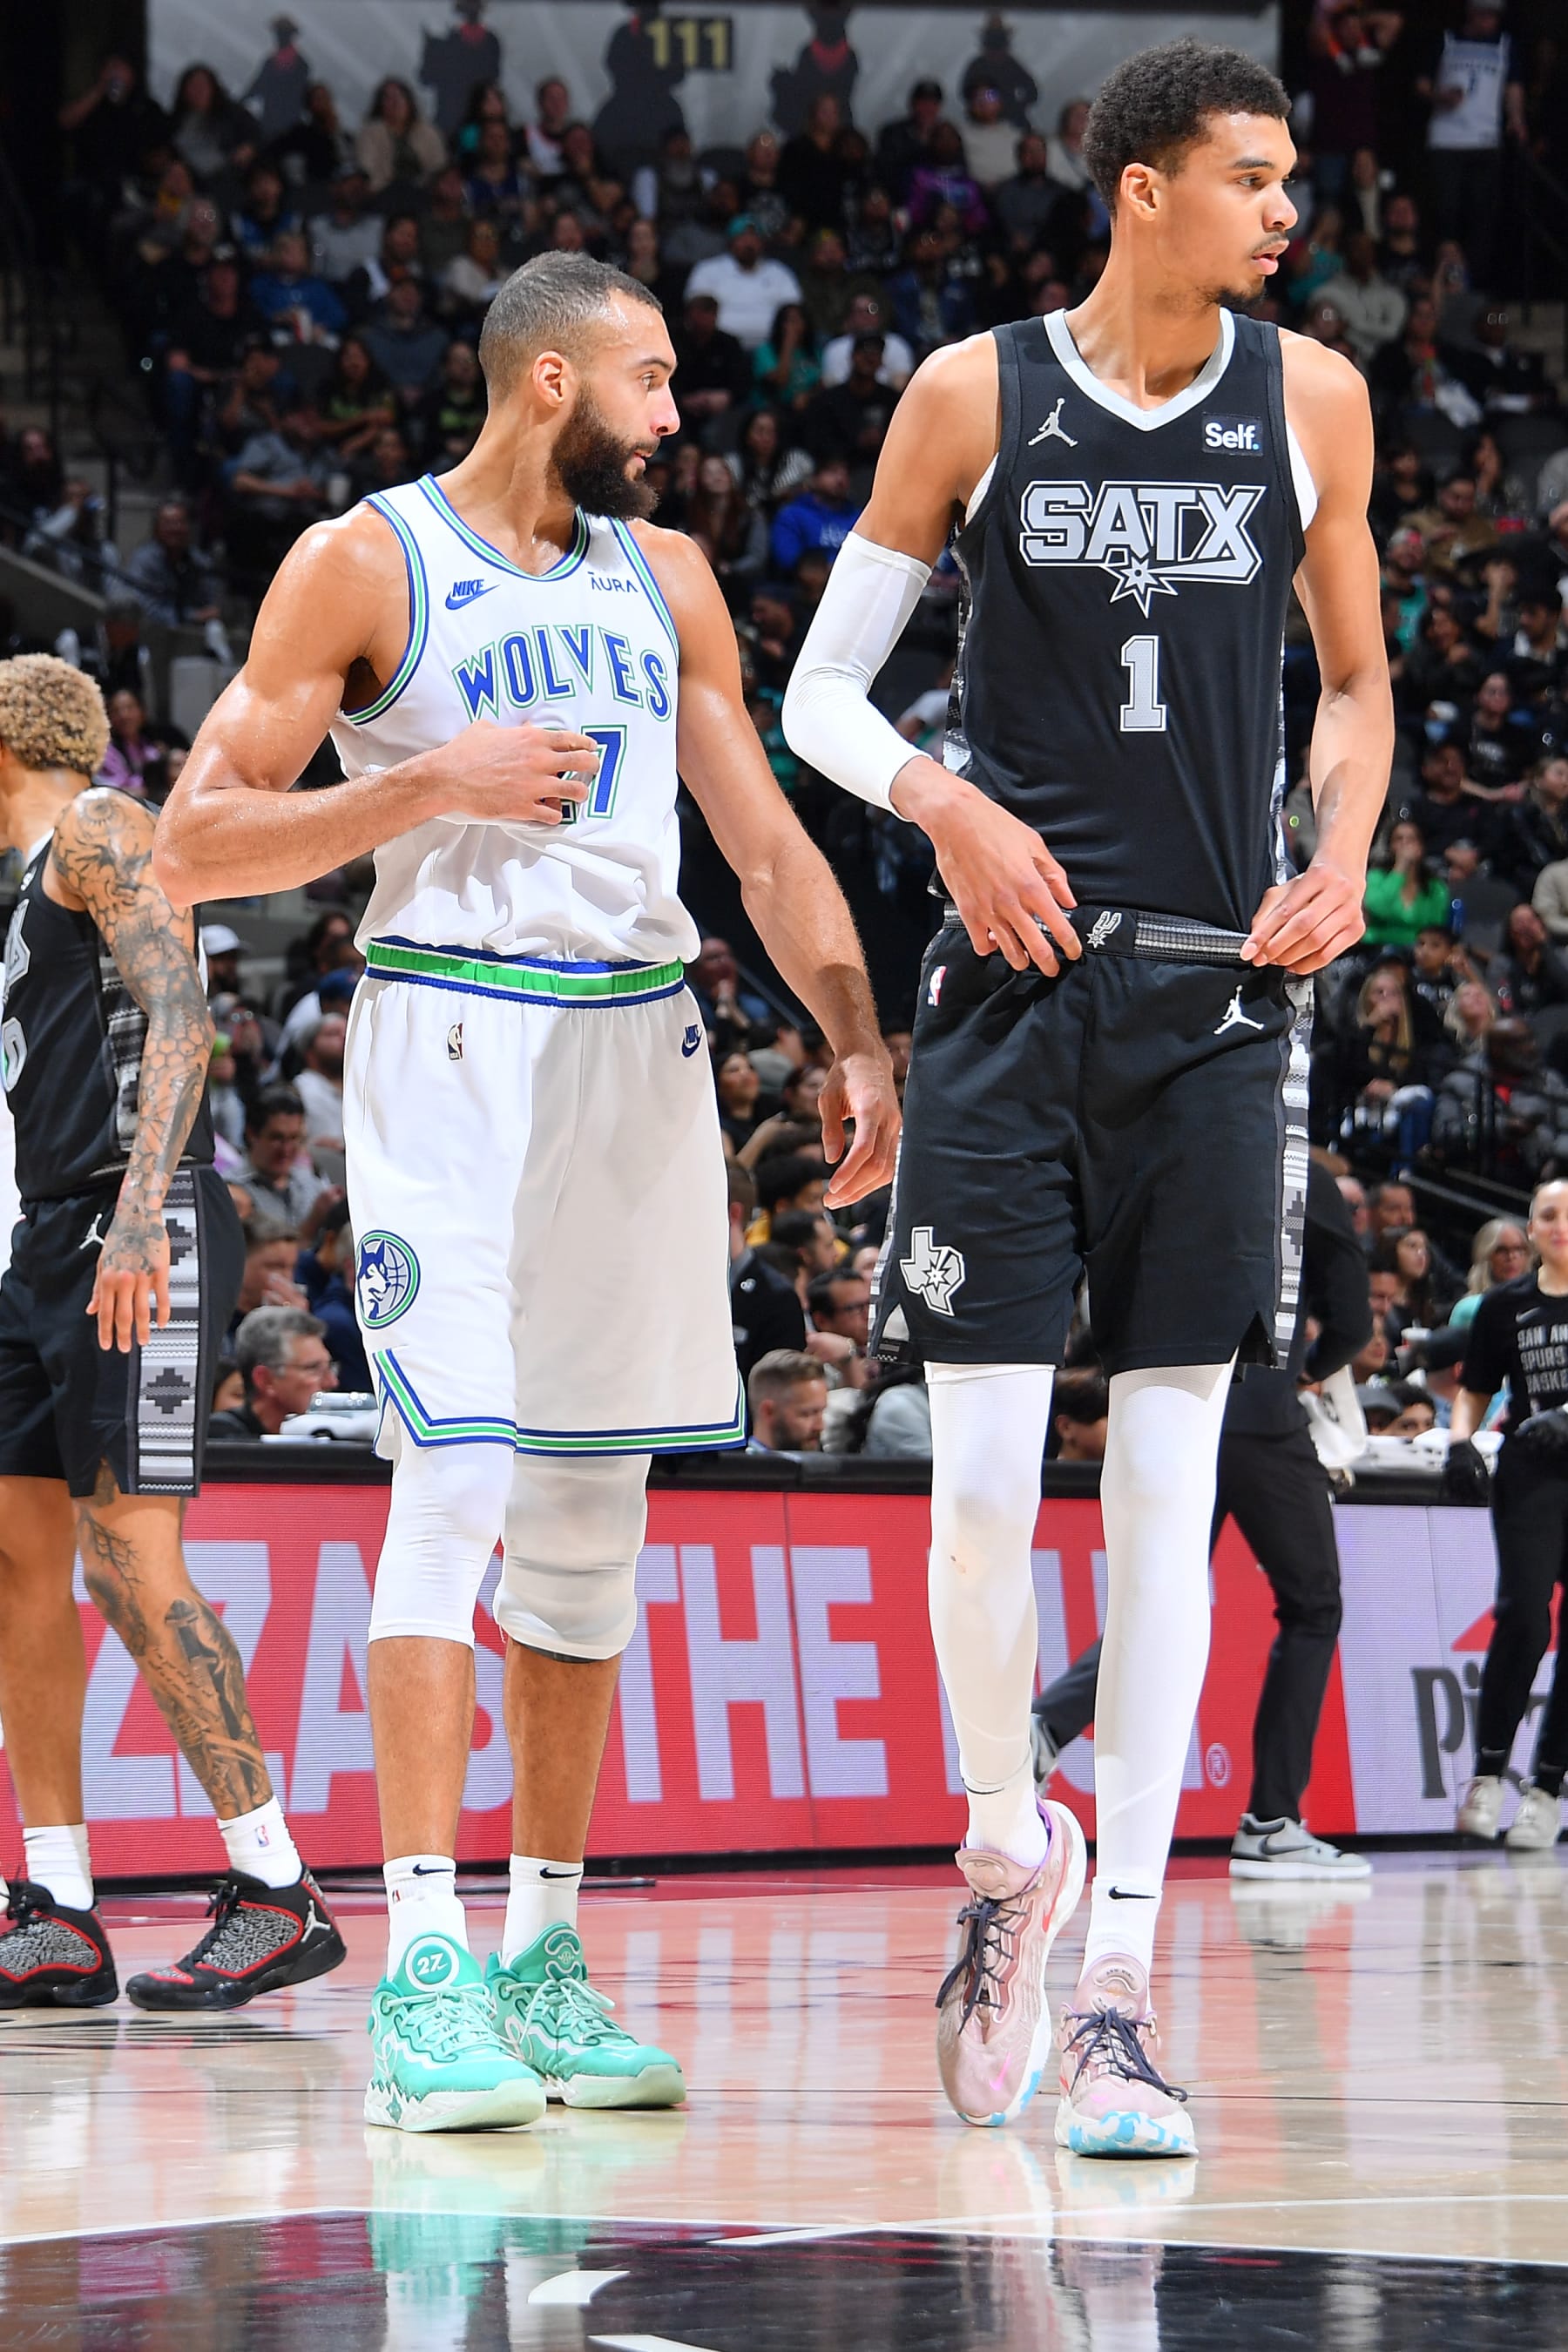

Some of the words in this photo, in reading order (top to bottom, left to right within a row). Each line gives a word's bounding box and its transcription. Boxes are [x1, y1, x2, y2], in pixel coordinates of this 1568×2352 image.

[646, 19, 728, 67] 111
[1019, 480, 1267, 585] SATX
[451, 578, 485, 598] NIKE
[451, 624, 672, 723] WOLVES
[1120, 634, 1166, 732] 1
[1517, 1325, 1543, 1352] SAN
[1520, 1344, 1565, 1372] SPURS
[619, 1544, 889, 1802] THE
[416, 1952, 448, 1976] 27
